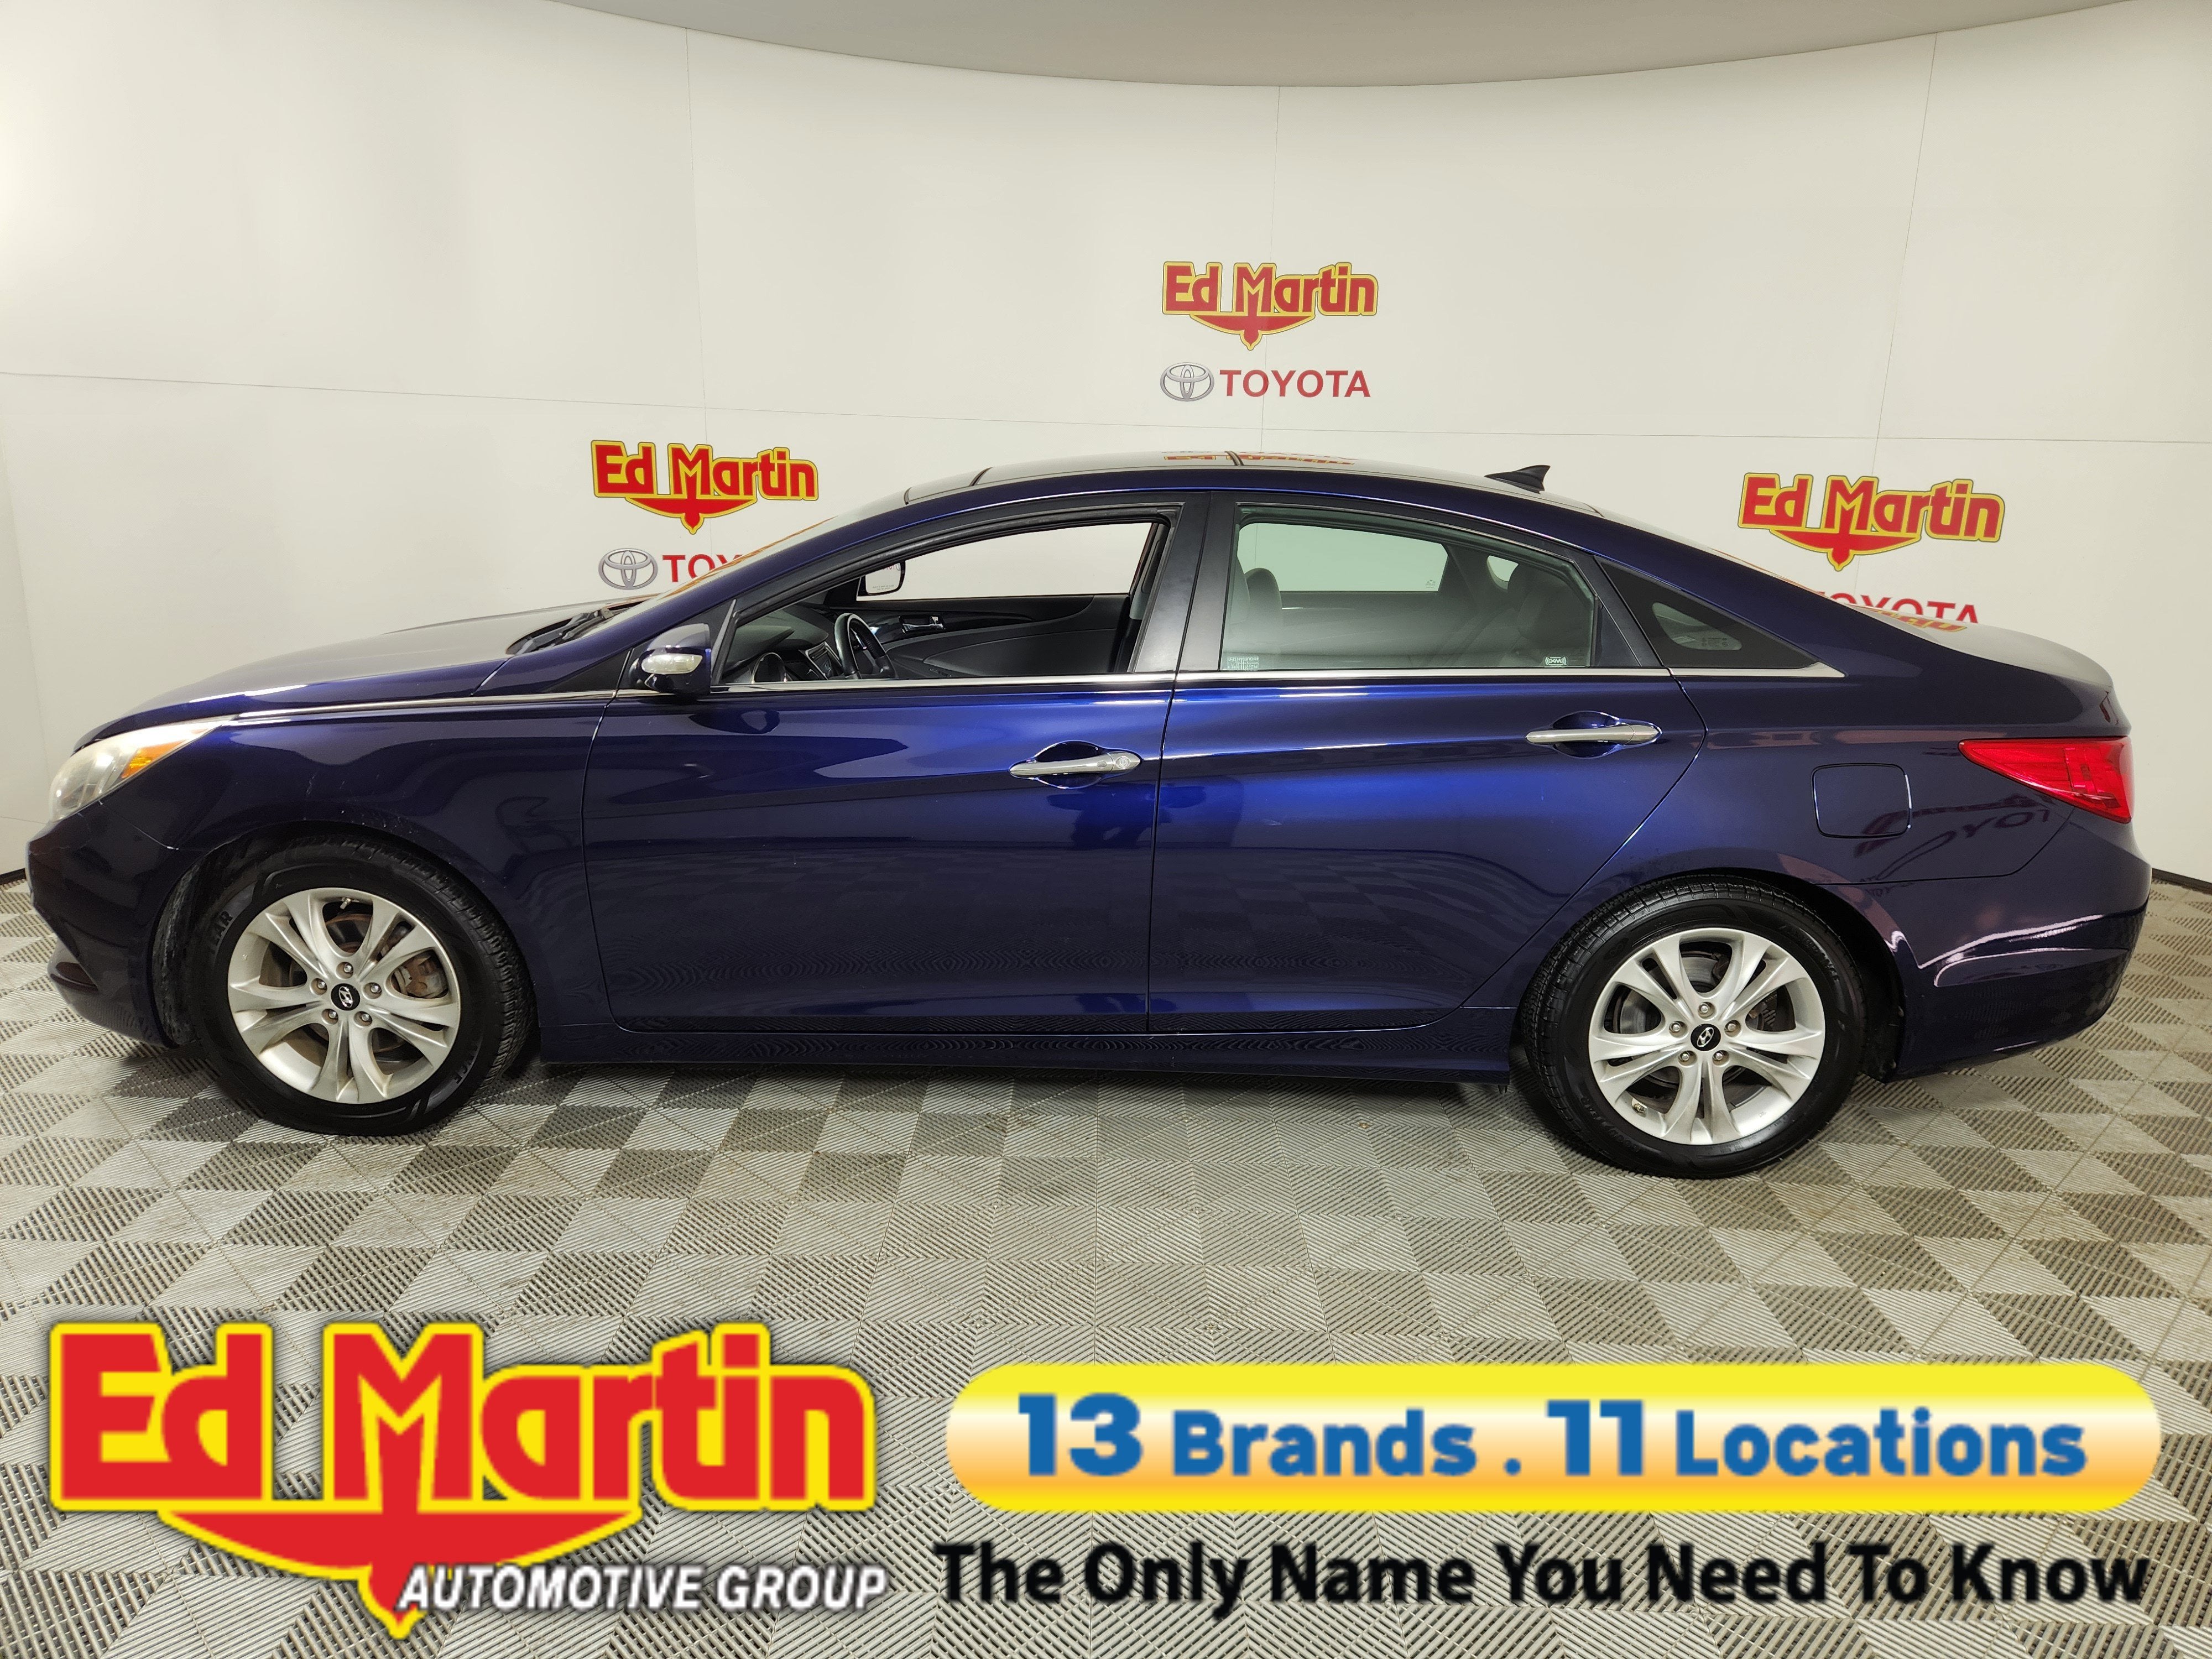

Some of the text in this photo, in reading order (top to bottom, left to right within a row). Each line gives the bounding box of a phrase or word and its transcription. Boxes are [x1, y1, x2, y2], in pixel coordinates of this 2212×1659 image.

[1162, 262, 1378, 316] Ed Martin
[1219, 370, 1371, 398] TOYOTA
[591, 440, 819, 500] Ed Martin
[1738, 473, 2005, 542] Ed Martin
